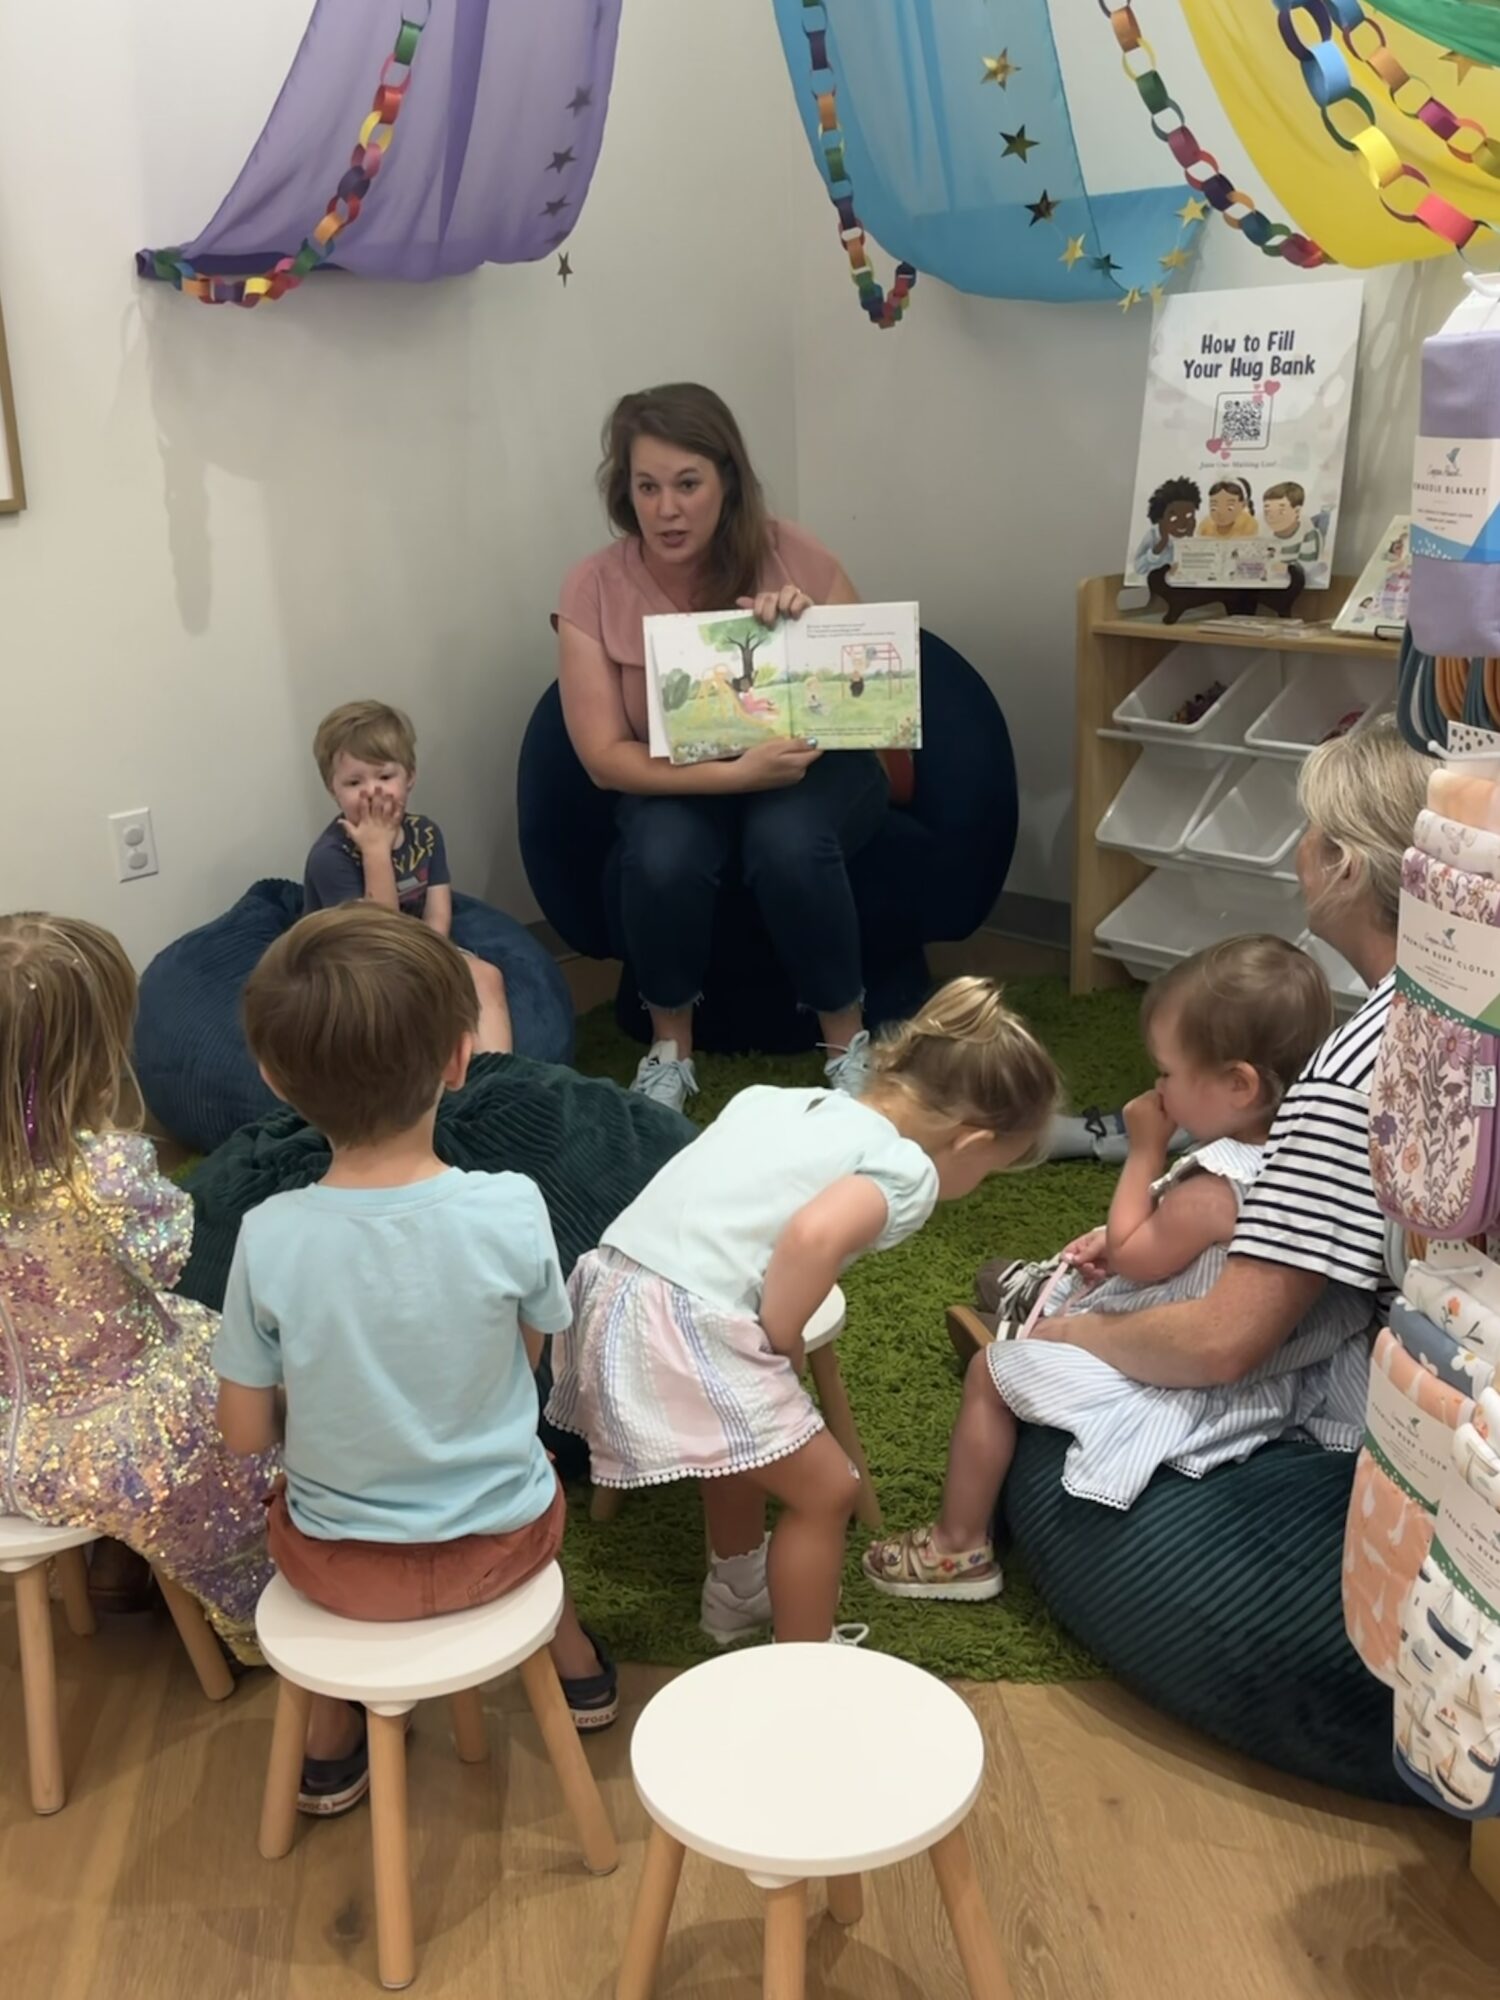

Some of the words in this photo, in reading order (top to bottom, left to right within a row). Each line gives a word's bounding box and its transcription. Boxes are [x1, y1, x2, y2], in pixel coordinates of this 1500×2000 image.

[1200, 333, 1236, 354] How
[1243, 334, 1261, 353] to
[1267, 329, 1295, 352] Fill
[1183, 359, 1223, 379] Your
[1229, 356, 1263, 381] Hug
[1270, 354, 1316, 376] Bank
[1445, 484, 1487, 496] BLANKET
[1456, 960, 1495, 978] CLOTHS
